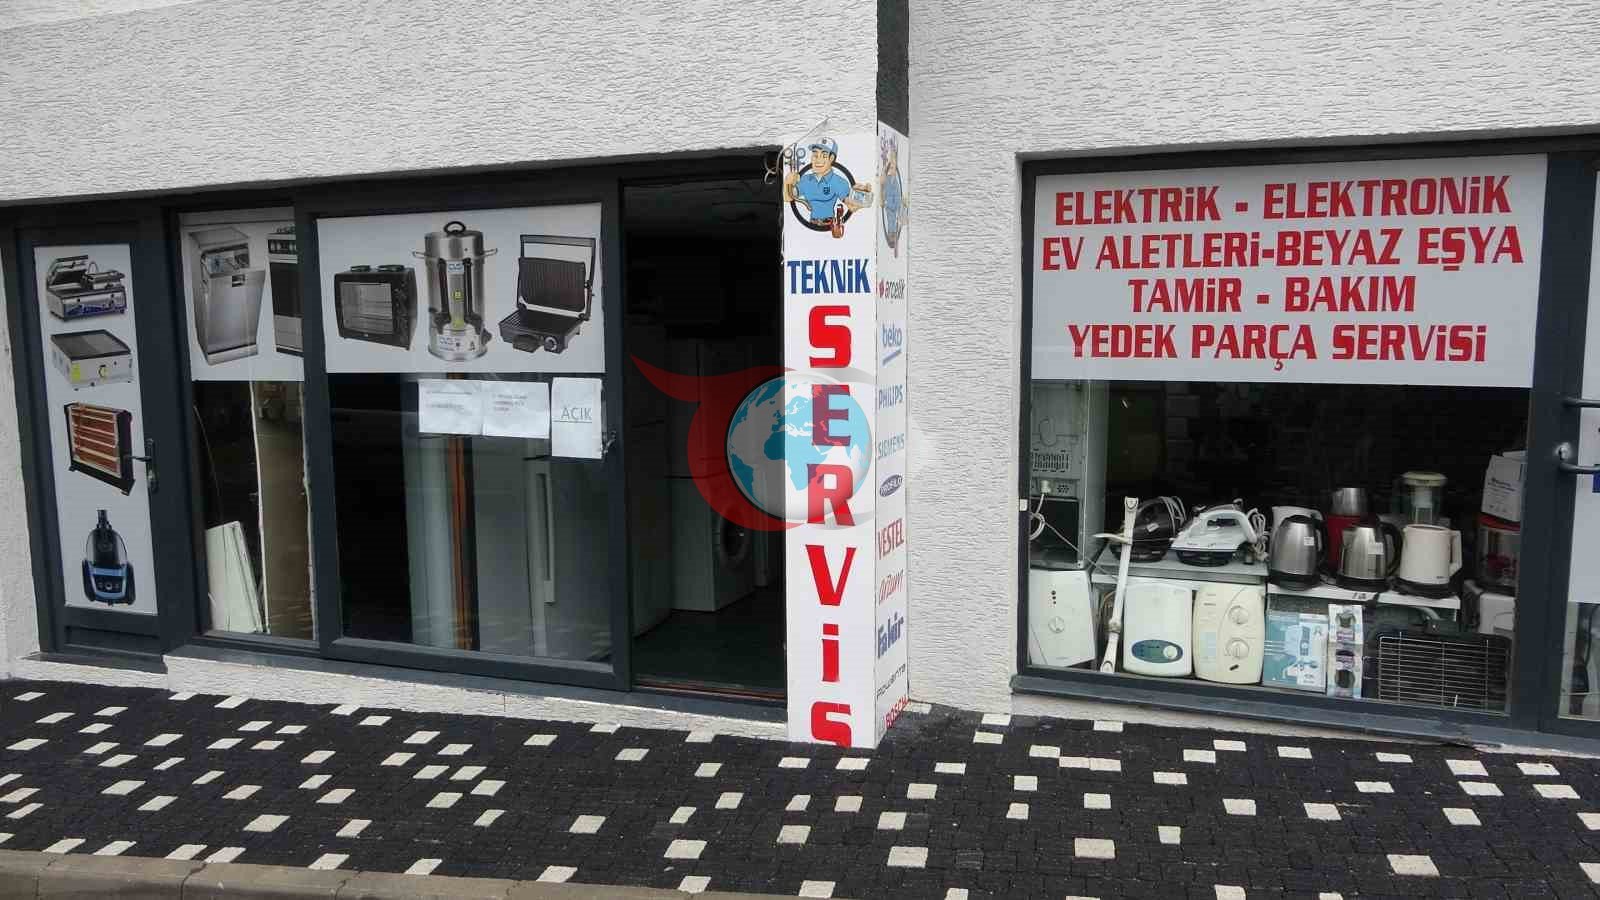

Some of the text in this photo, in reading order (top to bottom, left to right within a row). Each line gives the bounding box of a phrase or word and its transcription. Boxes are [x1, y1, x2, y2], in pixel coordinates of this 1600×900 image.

[1042, 236, 1085, 271] EV
[1417, 225, 1524, 272] EŞYA
[1284, 275, 1417, 313] BAKIM
[882, 321, 903, 348] beko
[1068, 324, 1178, 359] YEDEK
[1191, 324, 1318, 371] PARÇA
[879, 384, 904, 409] PHILIPS
[878, 433, 905, 460] SIEMENS
[878, 517, 905, 560] VESTEL
[877, 611, 904, 659] Fakir
